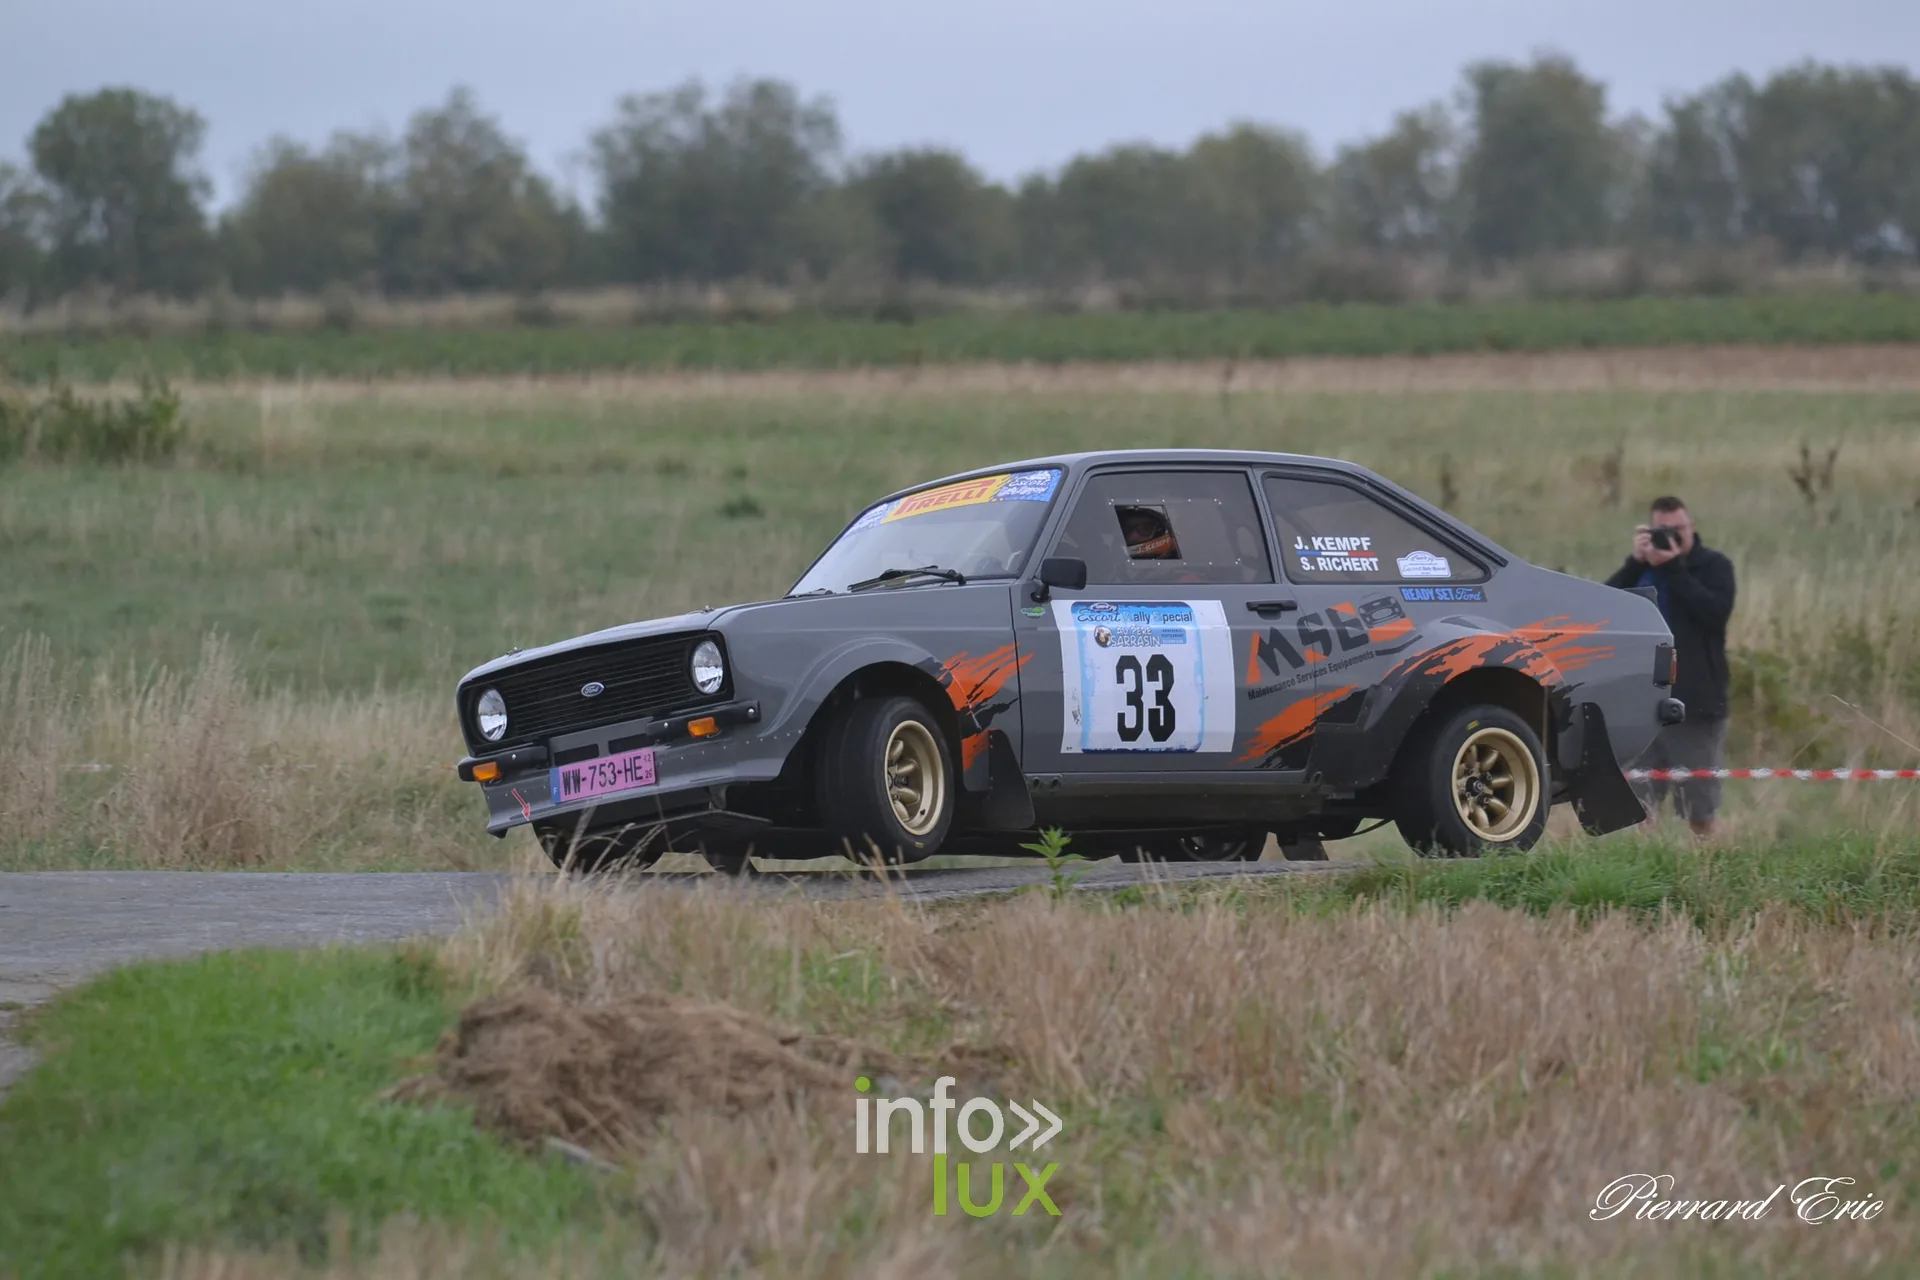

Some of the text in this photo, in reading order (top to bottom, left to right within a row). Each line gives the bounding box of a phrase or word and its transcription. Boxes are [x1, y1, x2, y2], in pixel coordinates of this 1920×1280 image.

[893, 479, 996, 516] PIRELLI
[1294, 536, 1371, 551] J. KEMPF
[1301, 558, 1379, 572] S. RICHERT
[1402, 587, 1481, 601] READY SET Ford
[1077, 608, 1193, 624] Escort Rally Special
[1117, 626, 1130, 636] AU
[1111, 635, 1161, 647] SARRASIN
[583, 684, 602, 695] Ford
[1248, 676, 1296, 700] Maintenance
[1296, 665, 1328, 684] Services
[1116, 654, 1176, 742] 33
[562, 756, 643, 796] WW-753-HE
